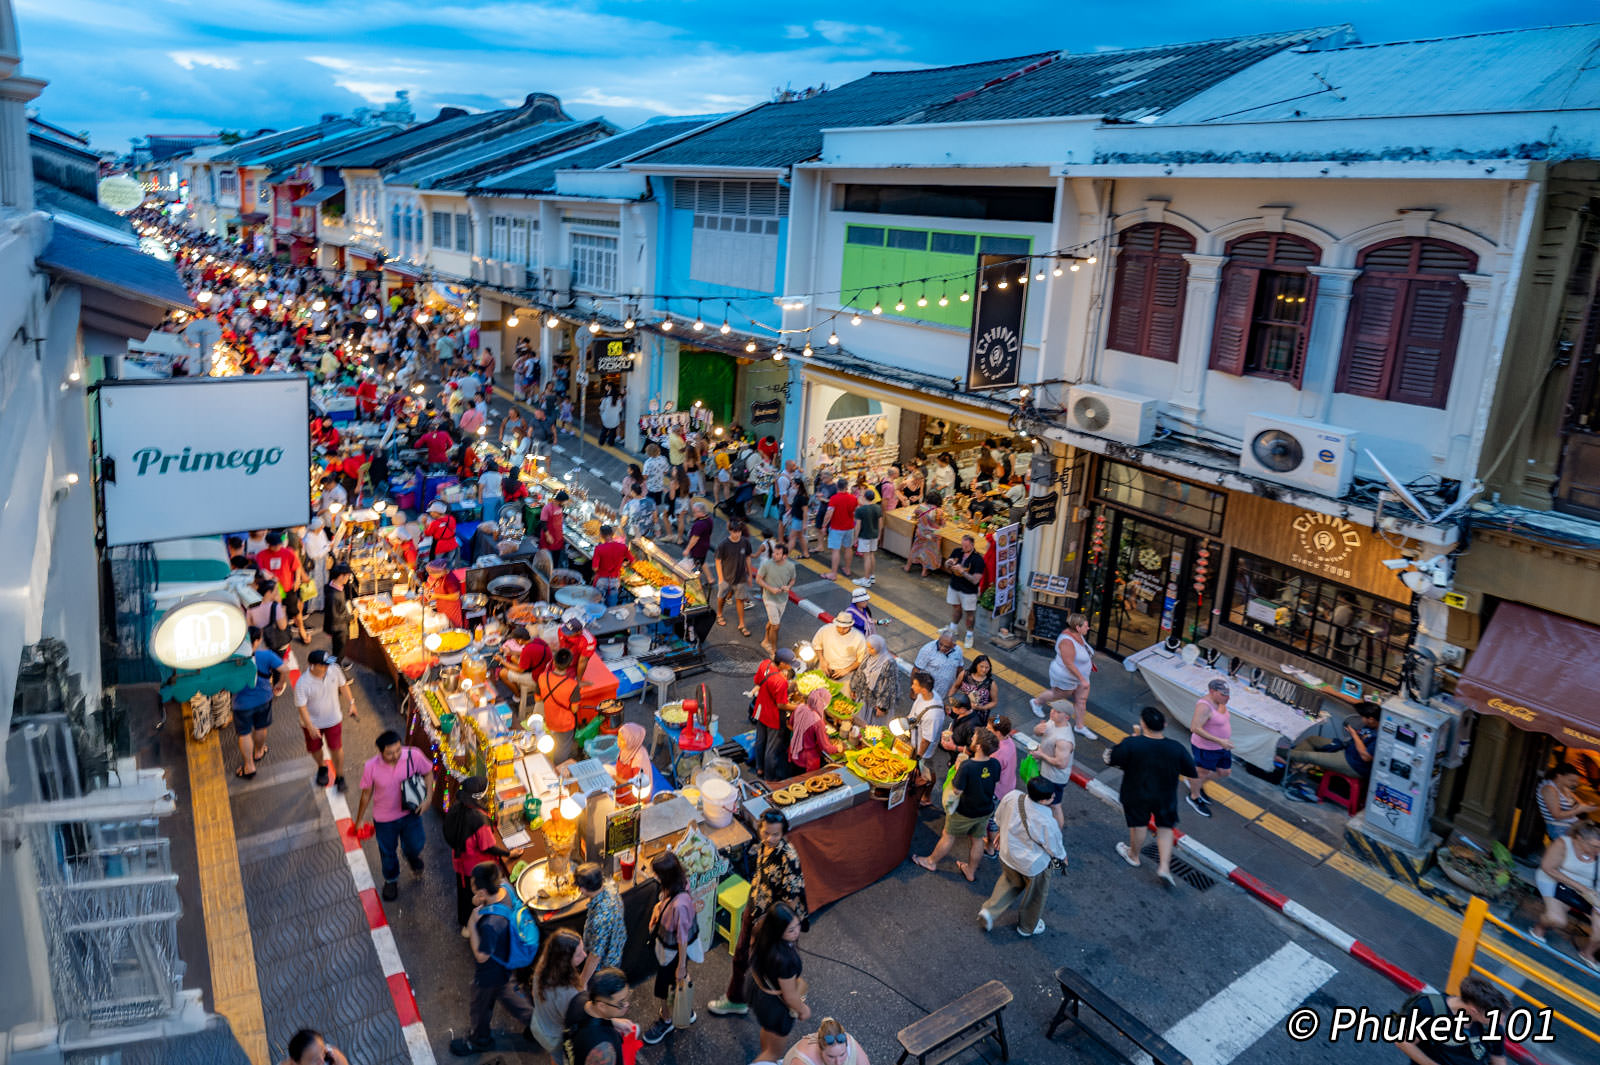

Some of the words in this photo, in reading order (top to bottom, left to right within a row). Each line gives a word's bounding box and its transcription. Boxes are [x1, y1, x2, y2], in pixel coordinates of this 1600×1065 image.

[132, 447, 285, 476] Primego
[1292, 512, 1361, 547] CHINO
[1292, 553, 1320, 569] Since
[1323, 564, 1351, 579] 2009
